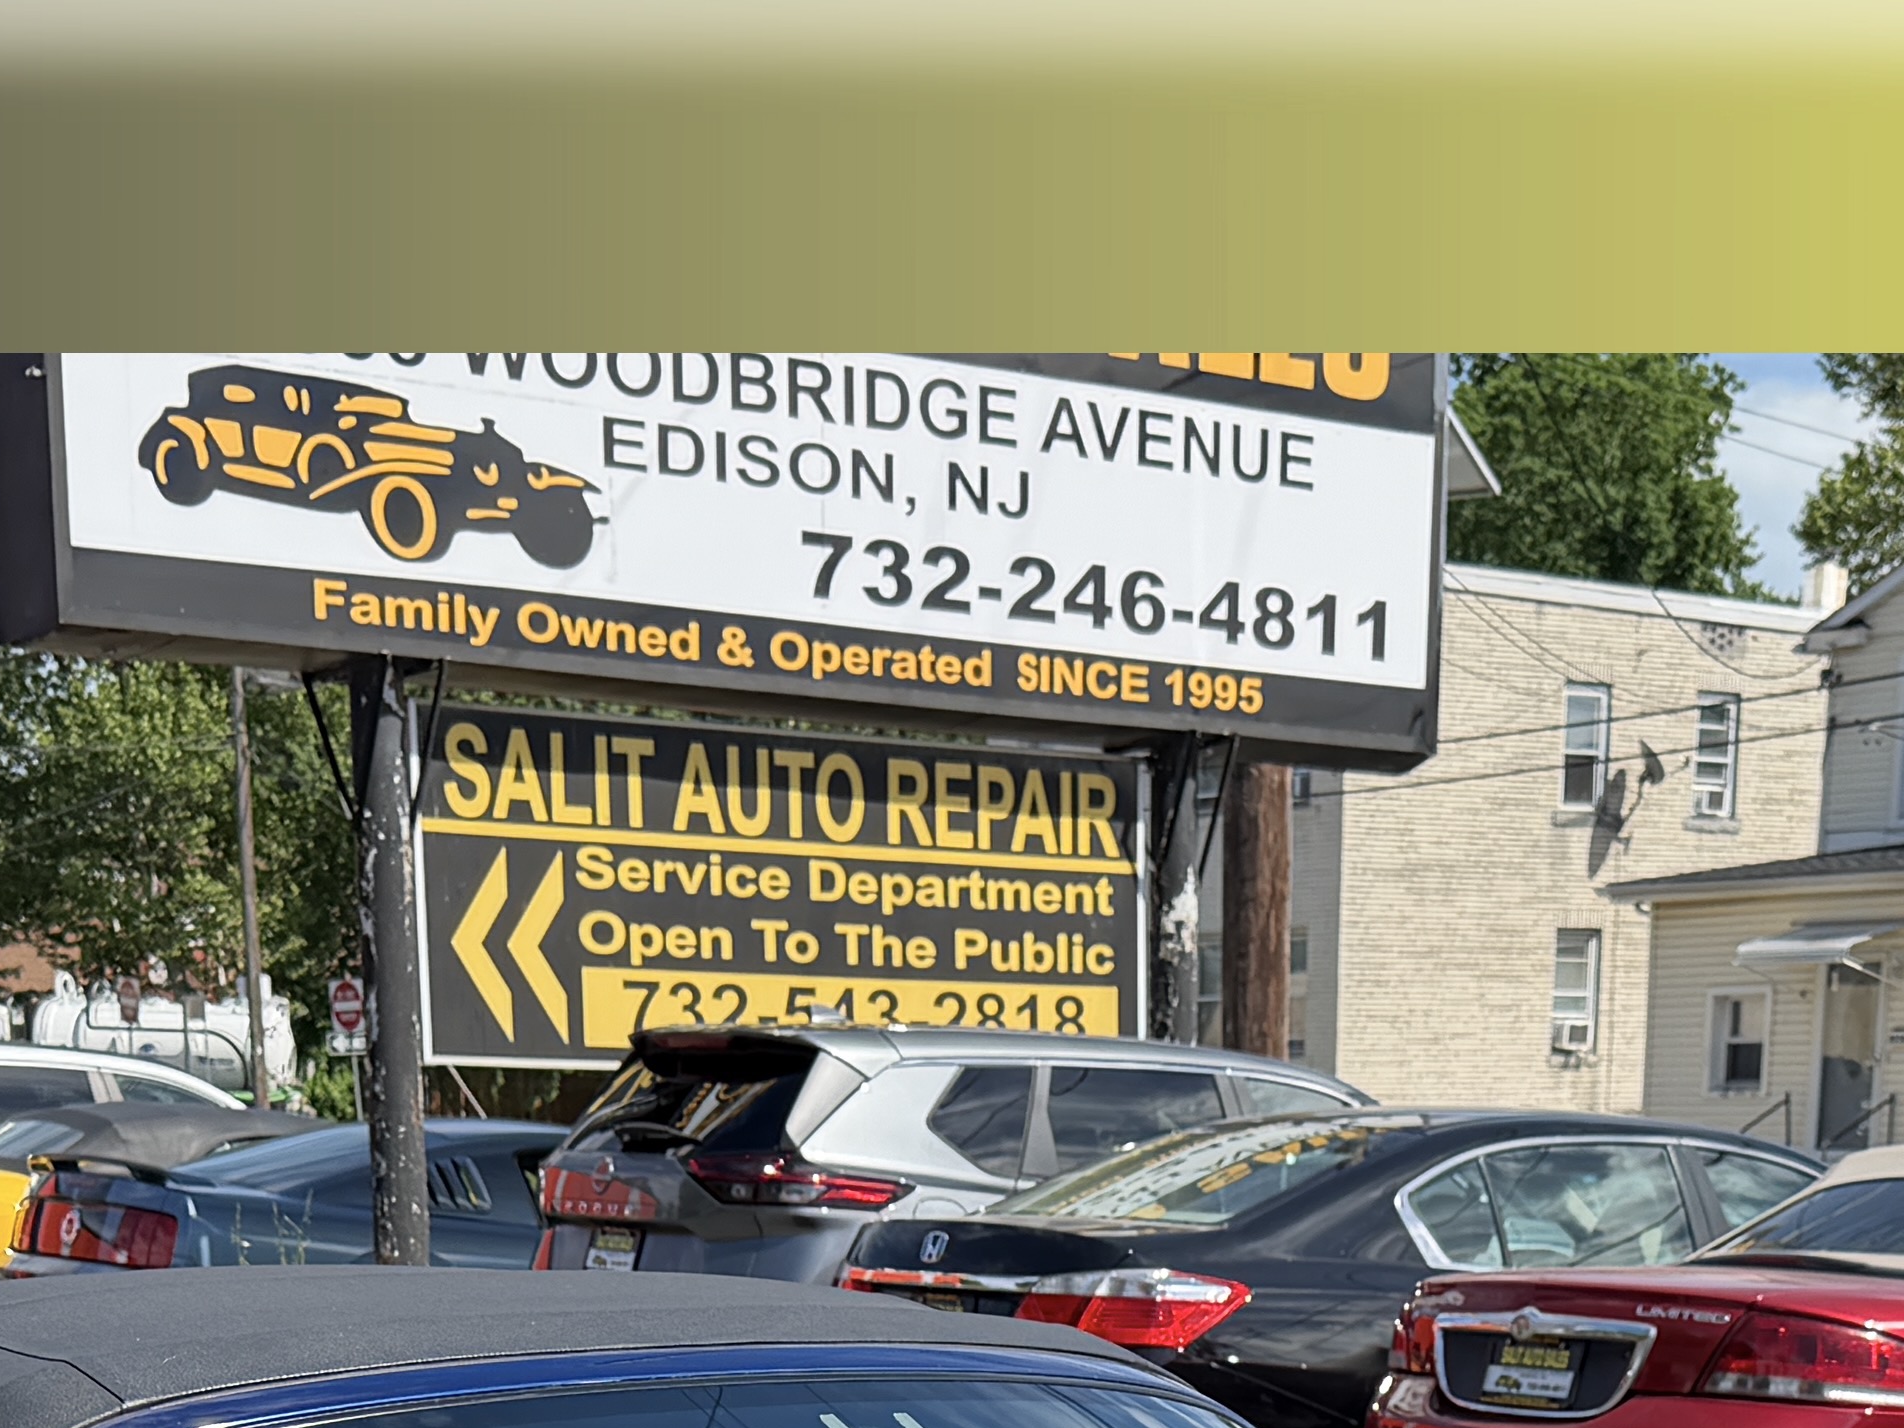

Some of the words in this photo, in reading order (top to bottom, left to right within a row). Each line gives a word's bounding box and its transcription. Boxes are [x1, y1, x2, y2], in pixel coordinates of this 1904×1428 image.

[602, 415, 917, 517] EDISON,
[946, 460, 1030, 519] NJ
[1040, 396, 1314, 491] AVENUE
[312, 578, 500, 646] Family
[516, 601, 700, 661] Owned
[716, 626, 755, 668] &
[769, 631, 993, 687] Operated
[1016, 652, 1151, 703] SINCE
[1164, 668, 1264, 714] 1995
[801, 529, 1388, 662] 732-246-4811
[443, 722, 656, 829] SALIT
[672, 743, 865, 843] AUTO
[887, 757, 1121, 858] REPAIR
[575, 846, 791, 900] Service
[809, 859, 1114, 916] Department
[577, 910, 733, 966] Open
[751, 919, 820, 965] To
[834, 923, 938, 969] The
[954, 929, 1115, 975] Public
